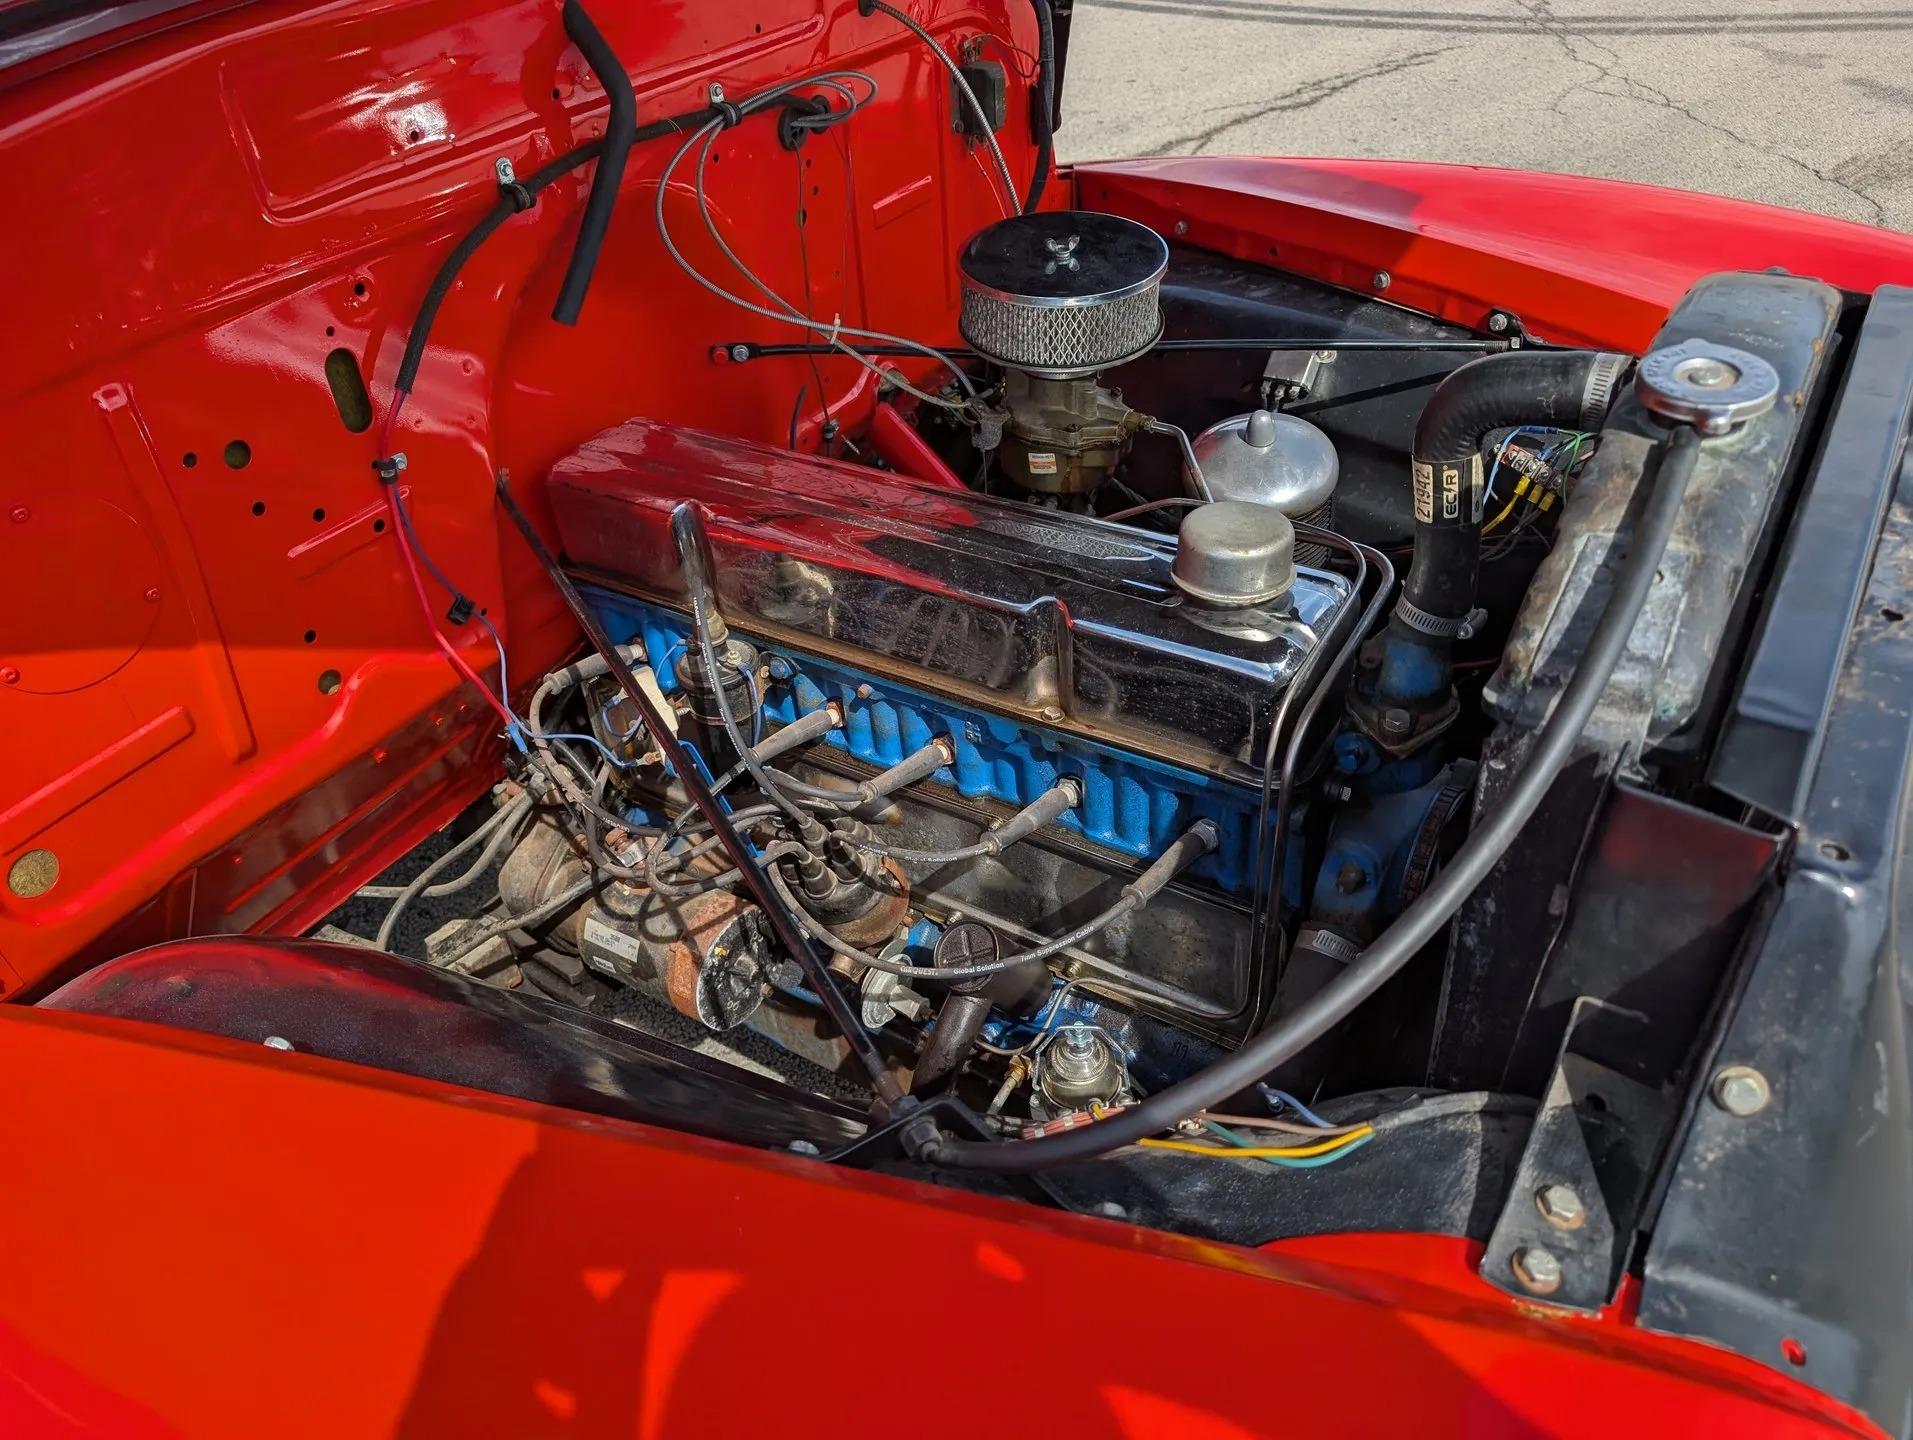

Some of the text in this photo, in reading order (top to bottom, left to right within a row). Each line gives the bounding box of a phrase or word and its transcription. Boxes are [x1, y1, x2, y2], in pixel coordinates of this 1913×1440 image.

[1416, 469, 1431, 519] 21942
[953, 966, 976, 975] Global
[976, 962, 1005, 972] Solution
[1020, 953, 1036, 962] 7mm
[1036, 936, 1076, 956] Suppression
[1076, 926, 1095, 938] Cable
